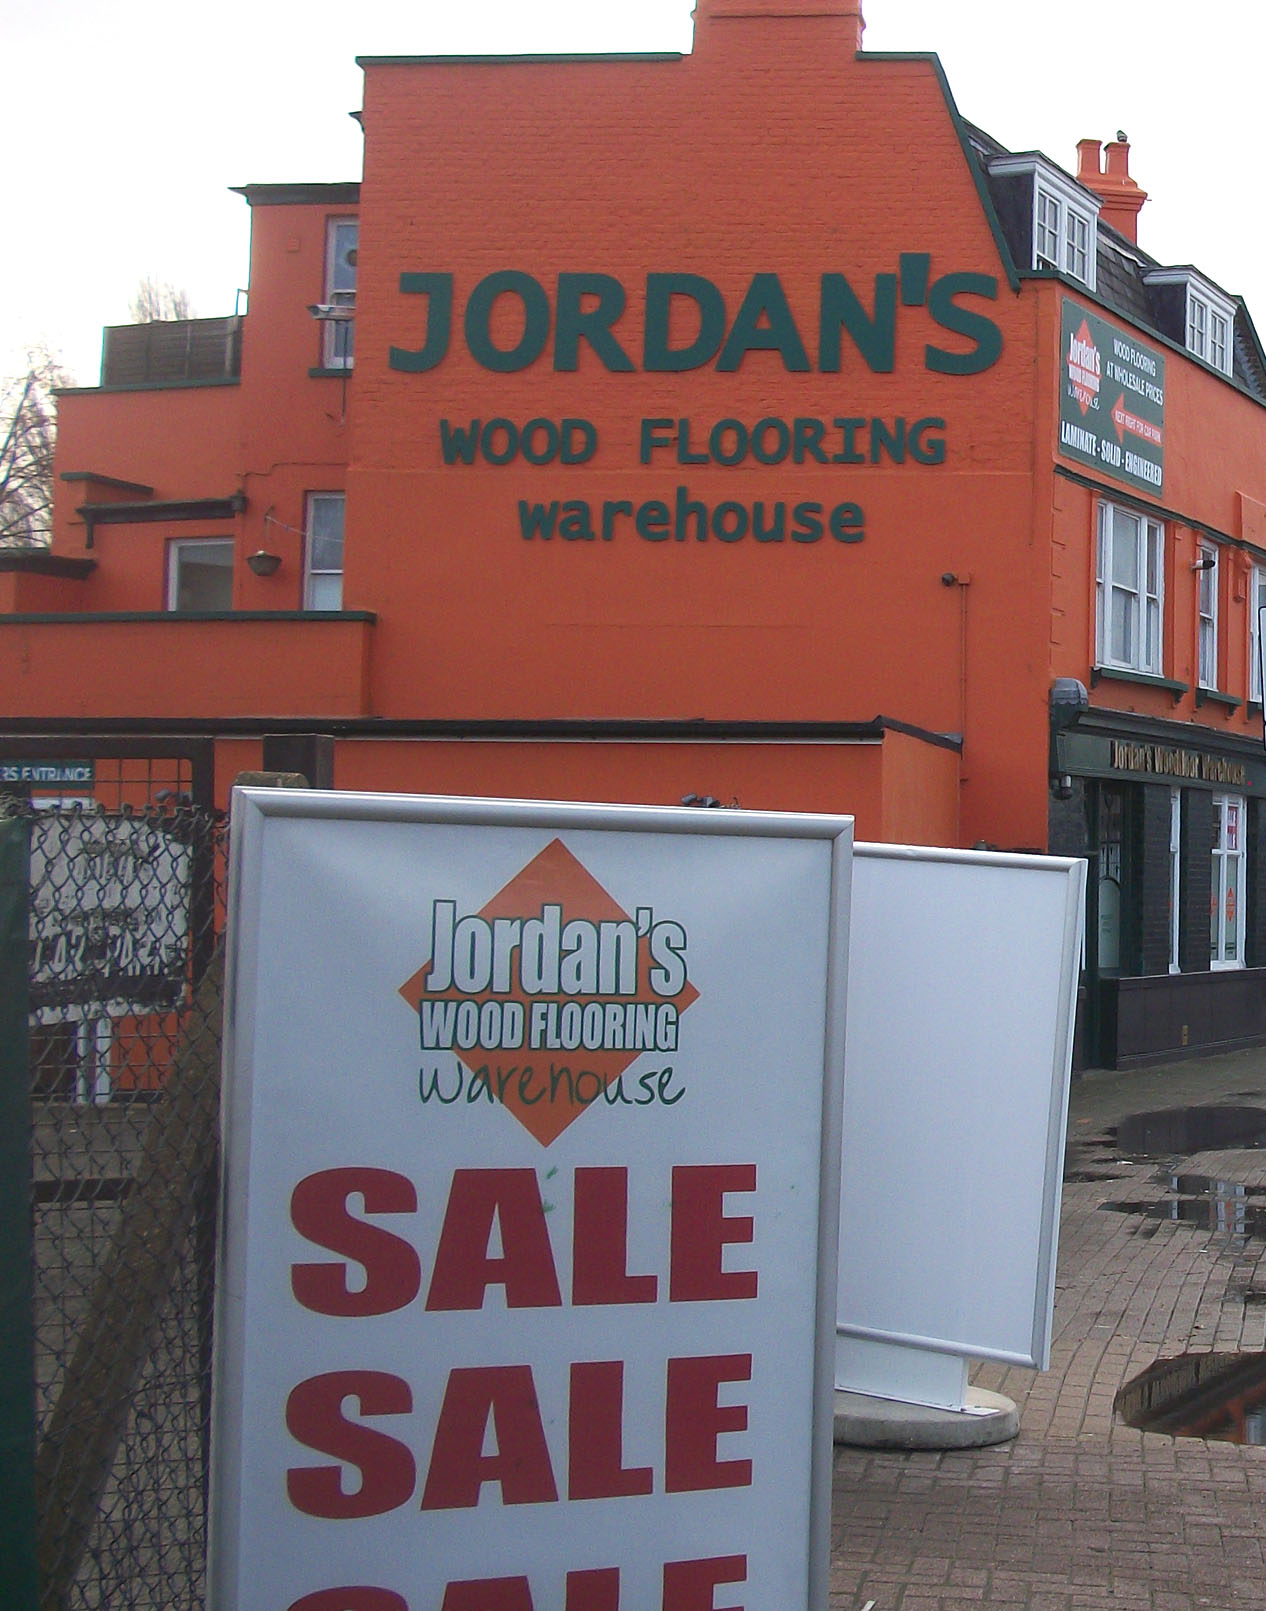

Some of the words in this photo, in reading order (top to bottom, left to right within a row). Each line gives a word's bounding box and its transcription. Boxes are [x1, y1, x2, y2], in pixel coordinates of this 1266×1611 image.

[389, 252, 1004, 376] JORDAN'S
[1069, 332, 1101, 376] Jordan's
[1113, 338, 1130, 362] WOOD
[1130, 348, 1156, 377] FLOORING
[1106, 361, 1115, 378] AT
[1114, 365, 1145, 396] WHOLESALE
[1145, 382, 1164, 406] PRICES
[439, 417, 598, 465] WOOD
[640, 416, 947, 465] FLOORING
[1061, 421, 1097, 456] LAMINATE
[1101, 439, 1121, 468] SOLID
[1125, 451, 1162, 487] ENGINEERED
[518, 486, 865, 543] warehouse
[1113, 740, 1152, 773] Jordan's
[423, 898, 688, 998] Jordan's
[419, 999, 526, 1052] WOOD
[528, 1002, 680, 1053] FLOORING
[290, 1163, 759, 1317] SALE
[285, 1353, 753, 1520] SALE
